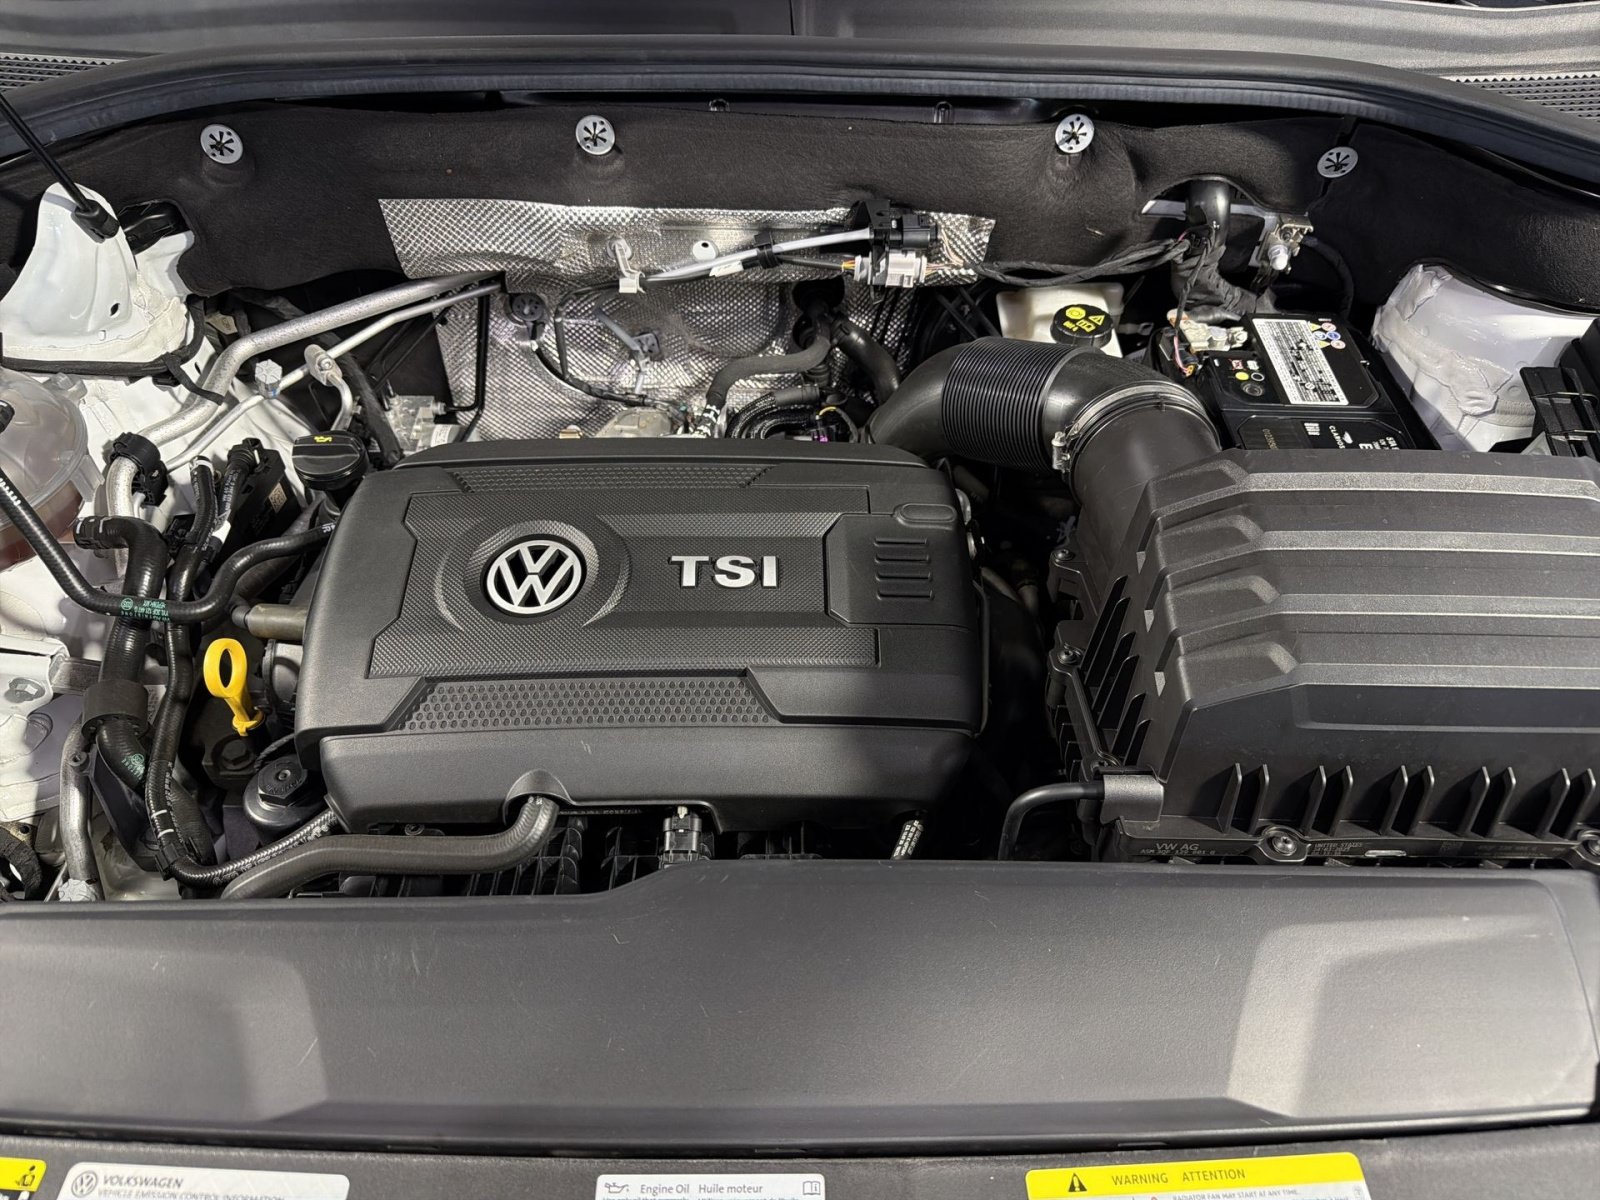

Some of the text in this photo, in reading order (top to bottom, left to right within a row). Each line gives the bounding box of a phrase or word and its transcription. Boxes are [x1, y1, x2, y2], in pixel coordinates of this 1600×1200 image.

[670, 555, 779, 588] TSI
[1181, 843, 1200, 851] AG
[103, 1174, 184, 1189] VOLKSWAGEN
[1111, 1168, 1246, 1186] WARNING ATTENTION
[135, 1189, 177, 1200] EMISSION
[179, 1191, 218, 1200] CONTROL
[640, 1183, 763, 1197] Engine Oil Huile moteur
[1207, 1192, 1221, 1200] FAN
[1238, 1191, 1257, 1199] START
[1268, 1189, 1281, 1197] ANY
